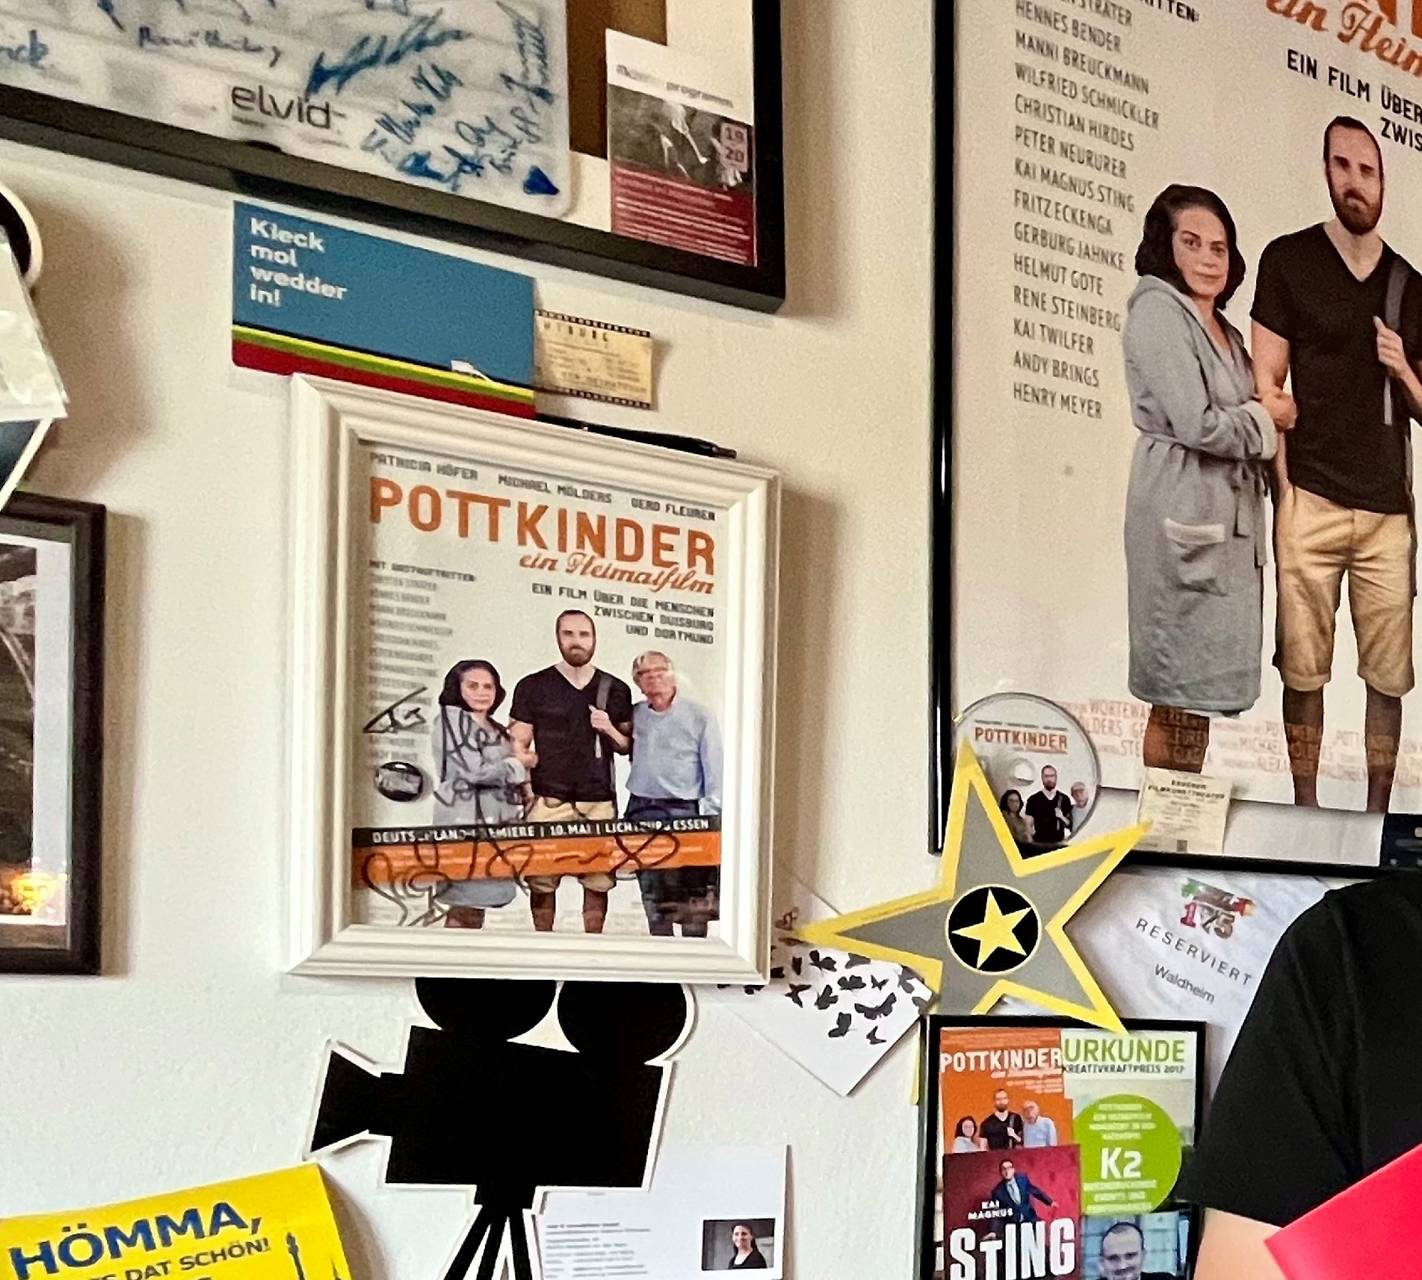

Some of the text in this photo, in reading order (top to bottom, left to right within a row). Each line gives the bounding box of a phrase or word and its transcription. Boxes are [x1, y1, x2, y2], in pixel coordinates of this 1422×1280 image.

[1016, 0, 1122, 52] HENNES BENDER
[1015, 29, 1150, 95] MANNI BREUCKMANN
[1287, 49, 1318, 80] EIN
[1328, 66, 1370, 102] FILM
[231, 85, 331, 129] elvid
[1014, 61, 1159, 129] WILFRIED SCHMICKLER
[1014, 93, 1135, 151] CHRISTIAN HIRDES
[1015, 125, 1127, 179] PETER NEURURER
[1015, 157, 1135, 213] KAI MAGNUS STING
[1014, 189, 1114, 236] FRITZ ECKENGA
[250, 245, 298, 268] mol
[1014, 221, 1126, 272] GERBURG JAHNKE
[249, 266, 348, 300] wedder
[1014, 253, 1104, 296] HELMUT GOTE
[250, 284, 280, 307] in!
[1052, 295, 1121, 332] STEINBERG
[1014, 317, 1094, 355] KAI TWILFER
[1013, 350, 1099, 387] ANDY BRINGS
[1013, 382, 1103, 420] HENRY MEYER
[369, 475, 716, 576] POTTKINDER
[565, 551, 715, 594] Heimatfilm
[532, 582, 552, 596] EIN
[558, 586, 587, 600] FILM
[630, 596, 649, 609] DIE
[655, 600, 715, 618] MENSCHEN
[594, 605, 654, 624] ZWISCHEN
[626, 624, 649, 636] UND
[974, 727, 1068, 749] POTTKINDER
[673, 818, 709, 832] ESSEN
[1136, 917, 1252, 986] RESERVIERT
[939, 1047, 1063, 1073] POTTKINDER
[1064, 1038, 1185, 1063] URKUNDE
[1101, 1147, 1142, 1179] K2
[967, 1208, 1013, 1220] MAGNUS
[981, 1199, 1000, 1210] KAI
[9, 1201, 262, 1280] HÖMMA,
[124, 1237, 271, 1280] DAT SCHÖN!
[949, 1217, 1076, 1280] STING
